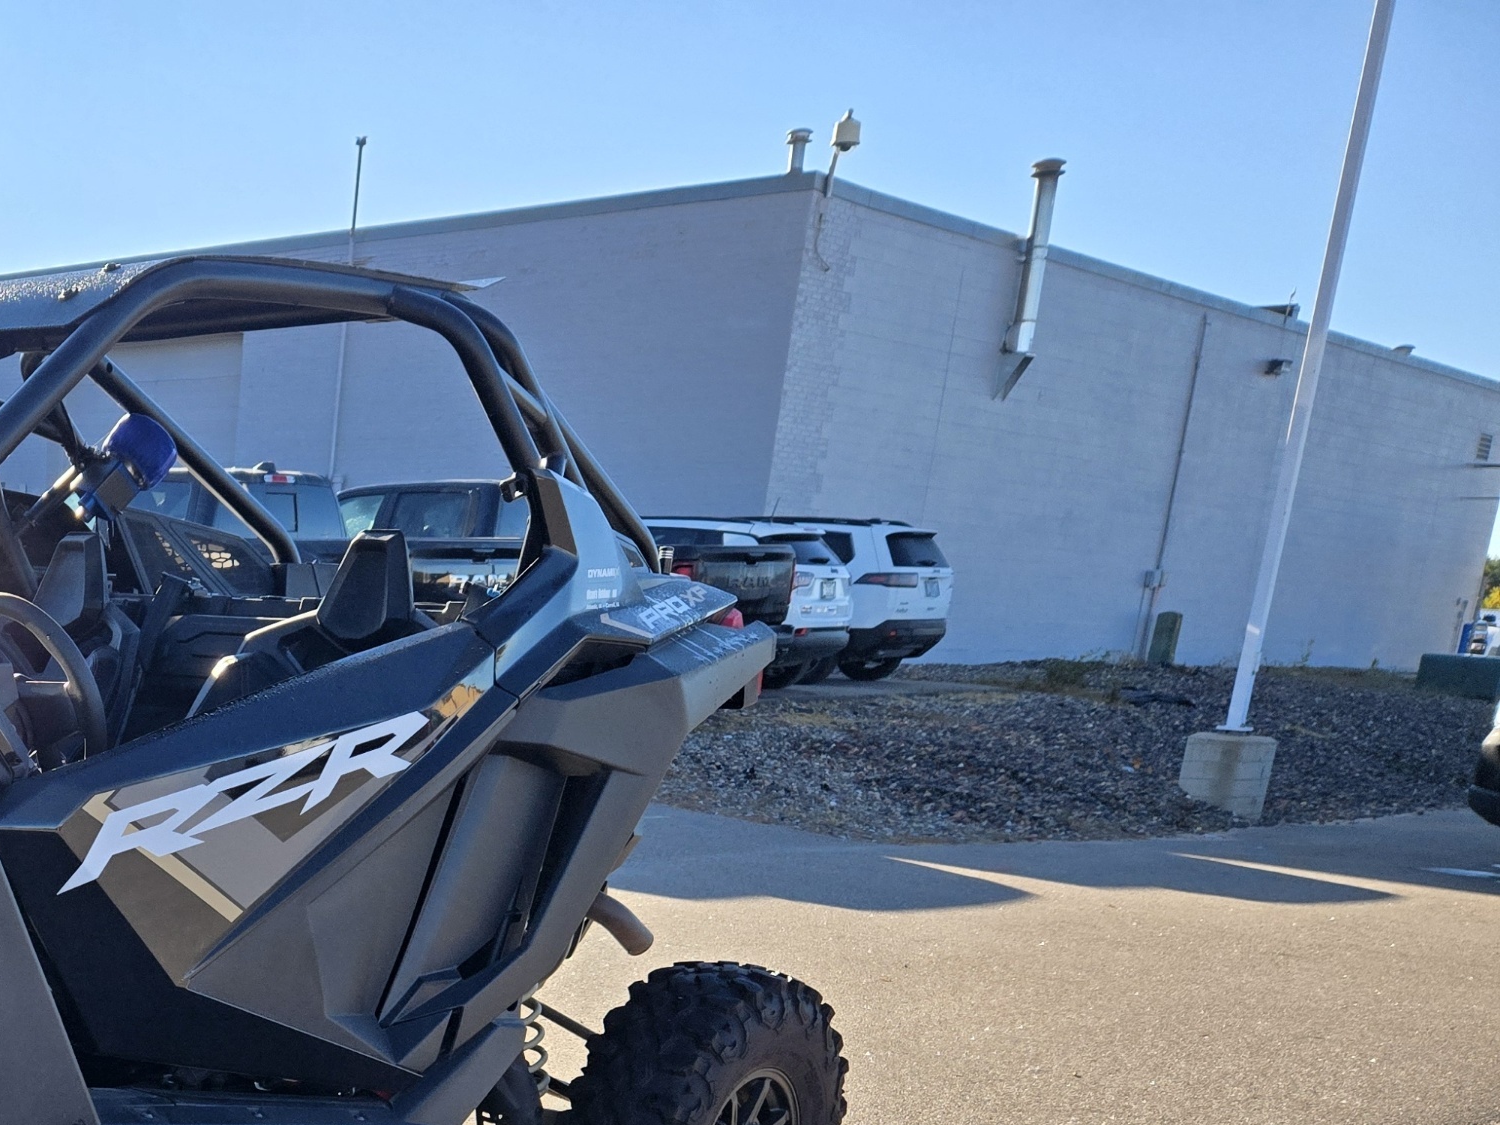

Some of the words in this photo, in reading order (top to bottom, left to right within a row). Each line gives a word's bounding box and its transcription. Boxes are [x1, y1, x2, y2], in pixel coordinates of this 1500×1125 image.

[638, 595, 691, 630] PRO
[679, 585, 708, 607] XP
[56, 711, 430, 895] RZR
